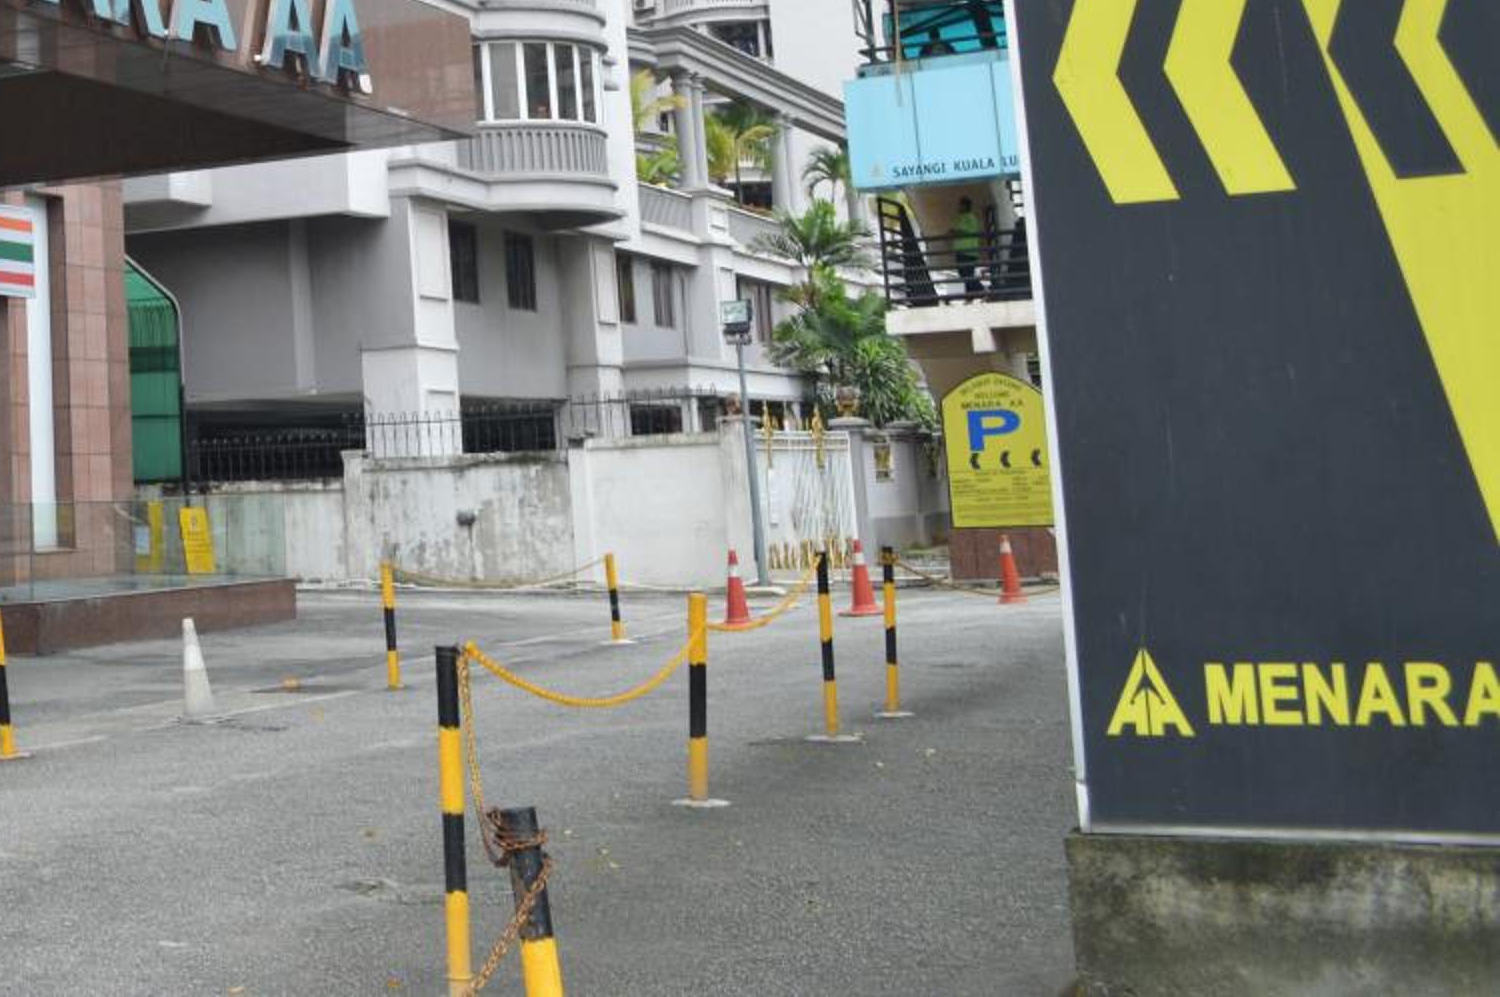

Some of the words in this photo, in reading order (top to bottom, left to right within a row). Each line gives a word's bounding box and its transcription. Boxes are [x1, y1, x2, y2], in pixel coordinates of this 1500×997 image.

[892, 162, 946, 179] SAYANGI
[953, 157, 995, 172] KUALA
[967, 408, 1022, 452] P
[1203, 662, 1500, 728] MENARA
